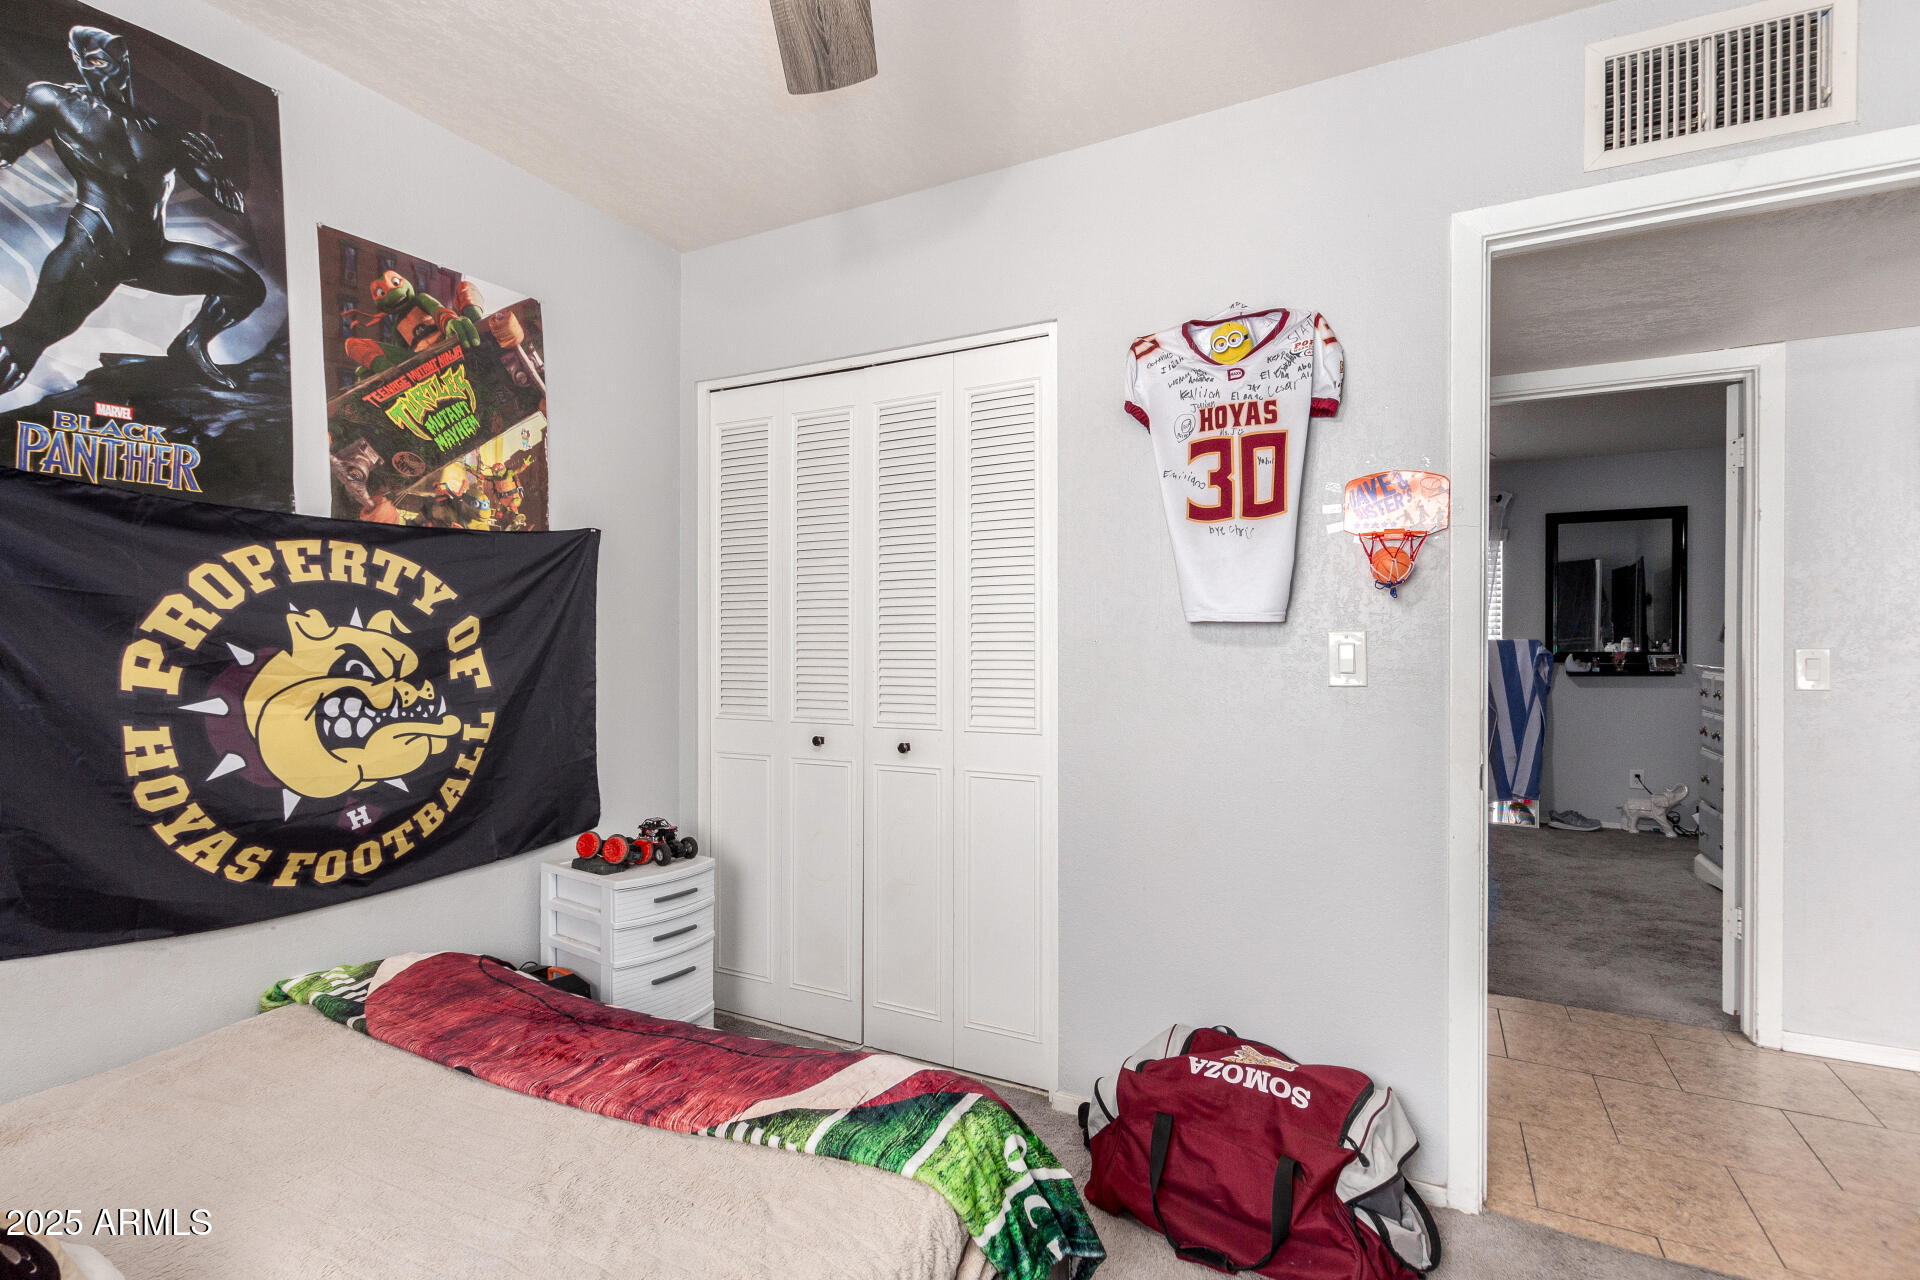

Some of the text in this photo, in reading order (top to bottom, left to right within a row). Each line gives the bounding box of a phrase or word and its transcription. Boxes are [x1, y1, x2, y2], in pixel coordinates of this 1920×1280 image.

[361, 344, 465, 408] TEENAGE MUTANT NINJA
[384, 363, 477, 441] TURTLES
[53, 410, 169, 444] BLACK
[96, 402, 132, 419] MARVEL
[424, 400, 471, 437] MUTANT
[433, 414, 480, 455] MAYHEM
[1198, 399, 1278, 433] HOYAS
[15, 420, 203, 493] PANTHER
[1186, 429, 1289, 524] 30
[120, 539, 493, 696] PROPERTY OF
[121, 711, 496, 888] HOYAS FOOTBALL
[345, 804, 373, 831] H
[1187, 1055, 1312, 1110] SOMOZA
